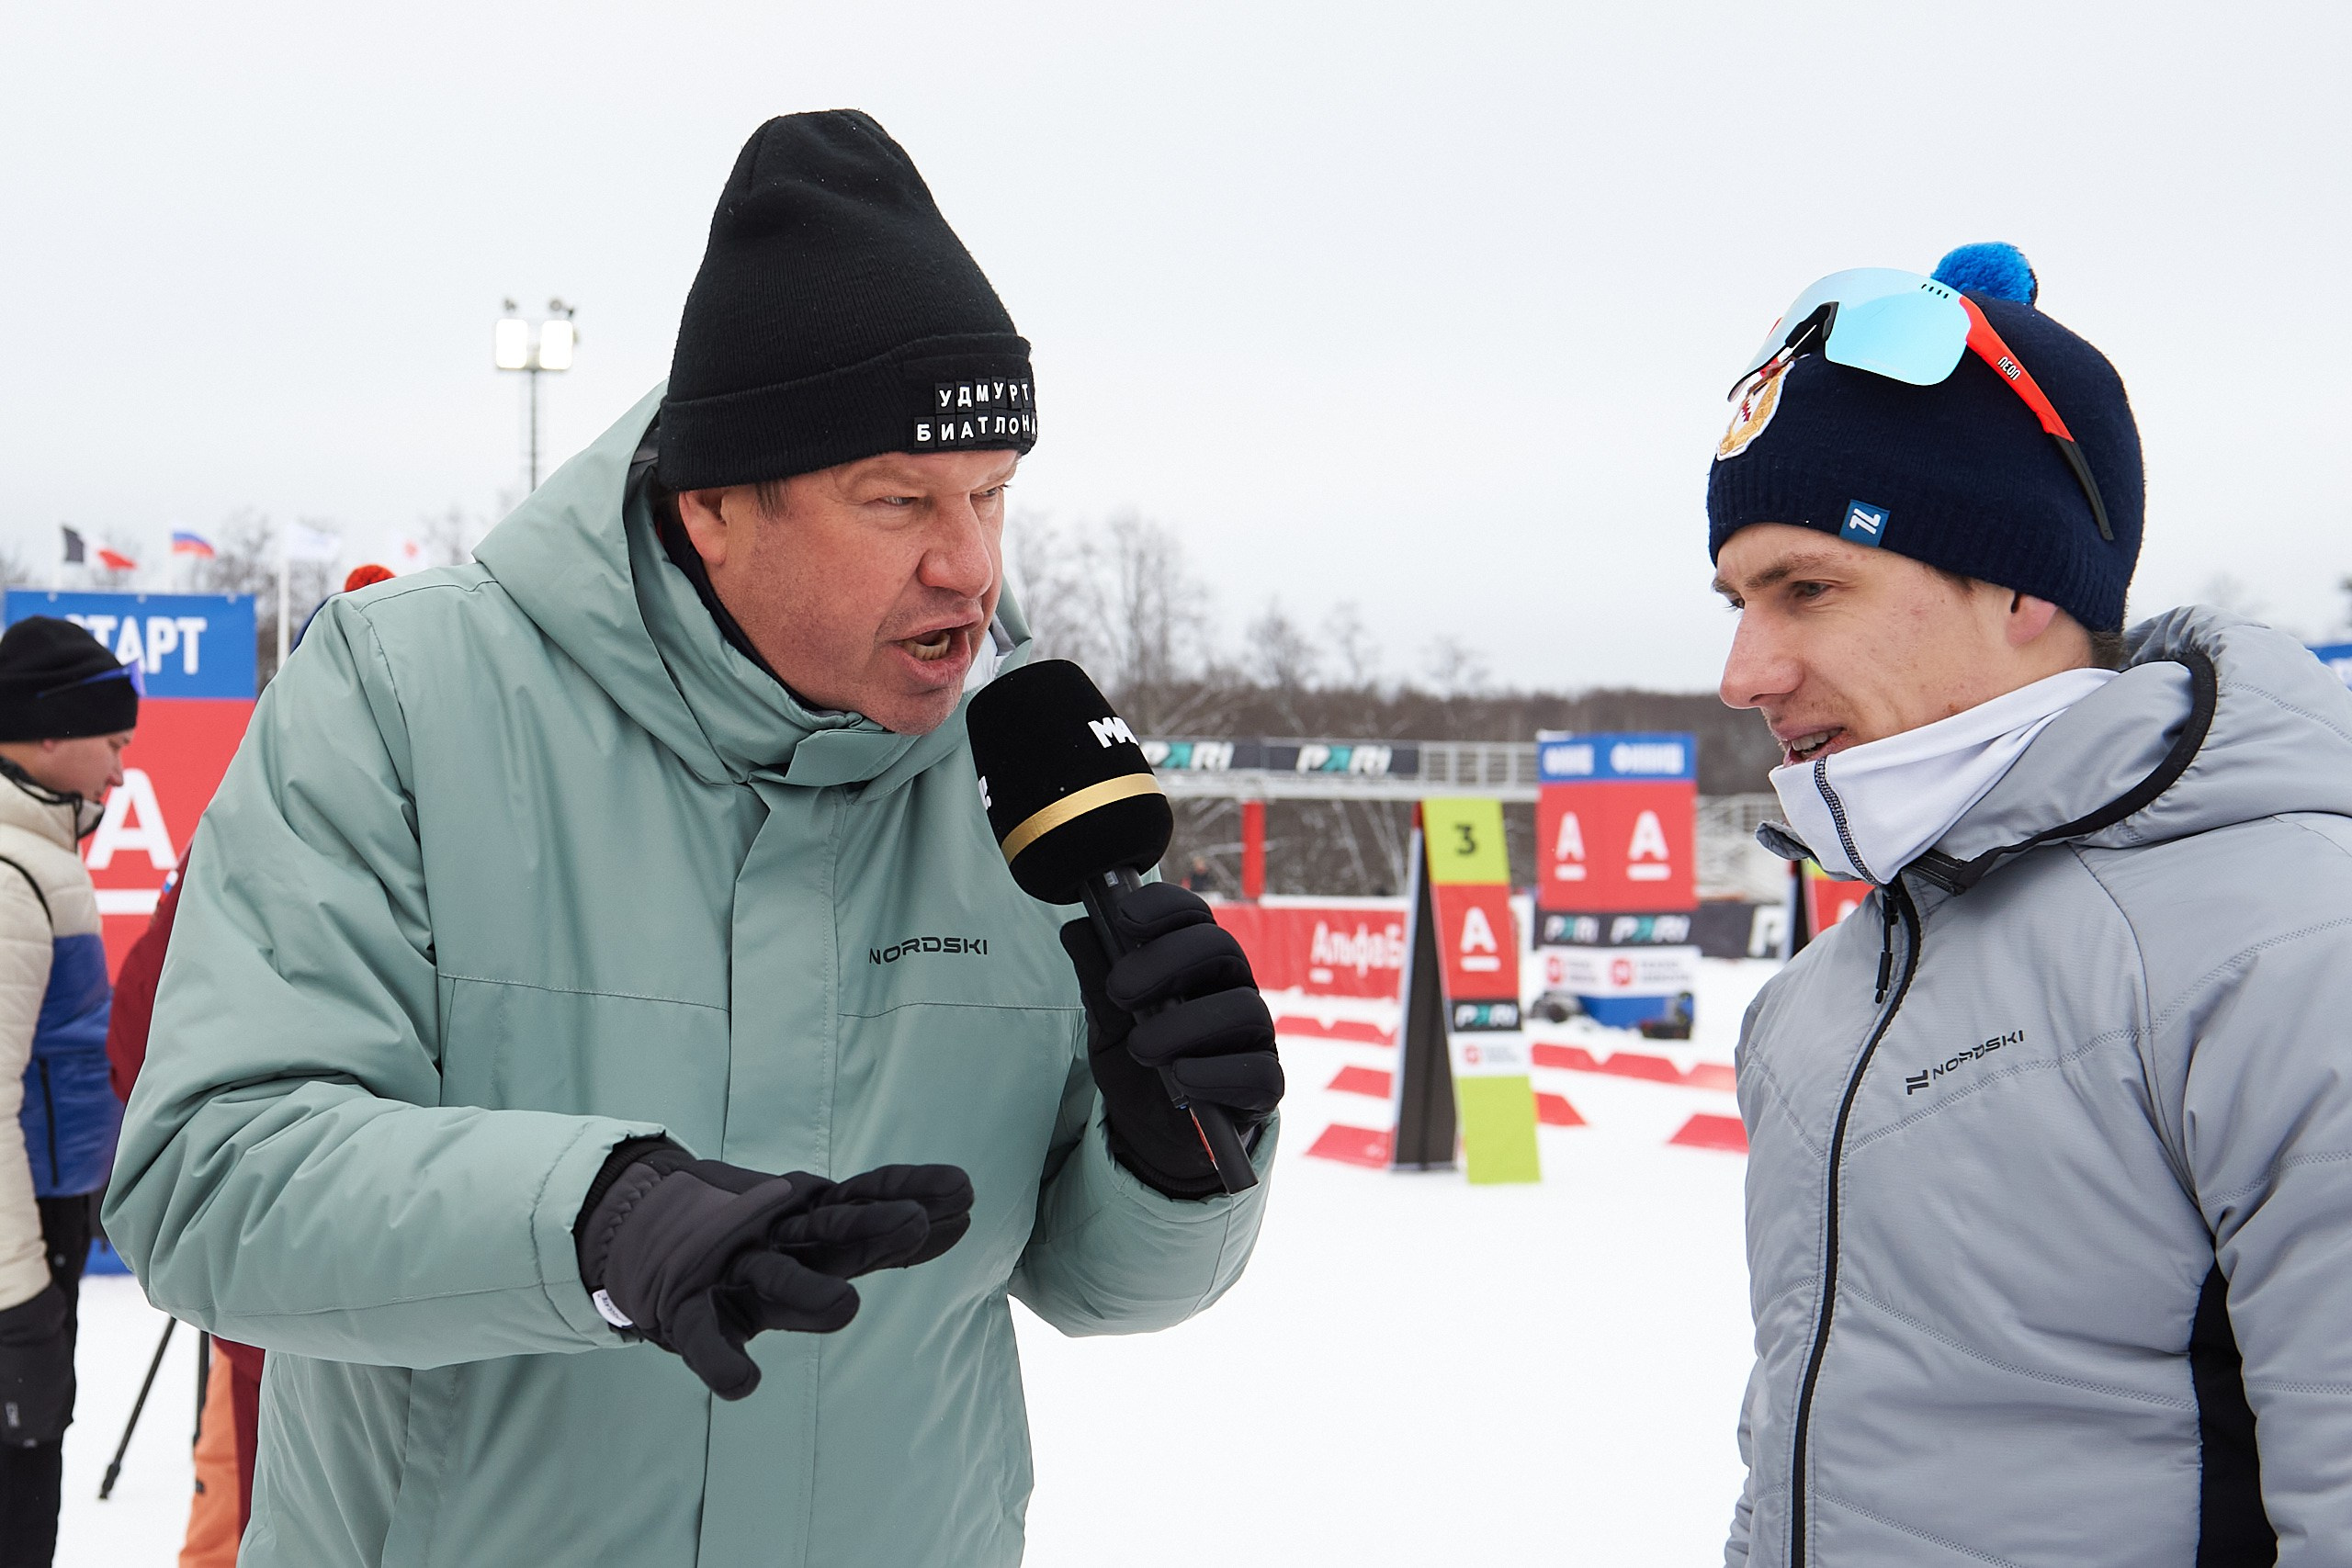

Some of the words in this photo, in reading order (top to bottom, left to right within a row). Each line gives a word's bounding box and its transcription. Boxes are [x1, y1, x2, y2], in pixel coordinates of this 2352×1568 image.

[1997, 356, 2020, 380] NEON
[939, 381, 1029, 408] УДМУРТ
[65, 614, 207, 675] ТАРТ
[1453, 822, 1476, 856] 3
[869, 937, 988, 964] NORDSKI
[1933, 1030, 2024, 1079] NORDSKI
